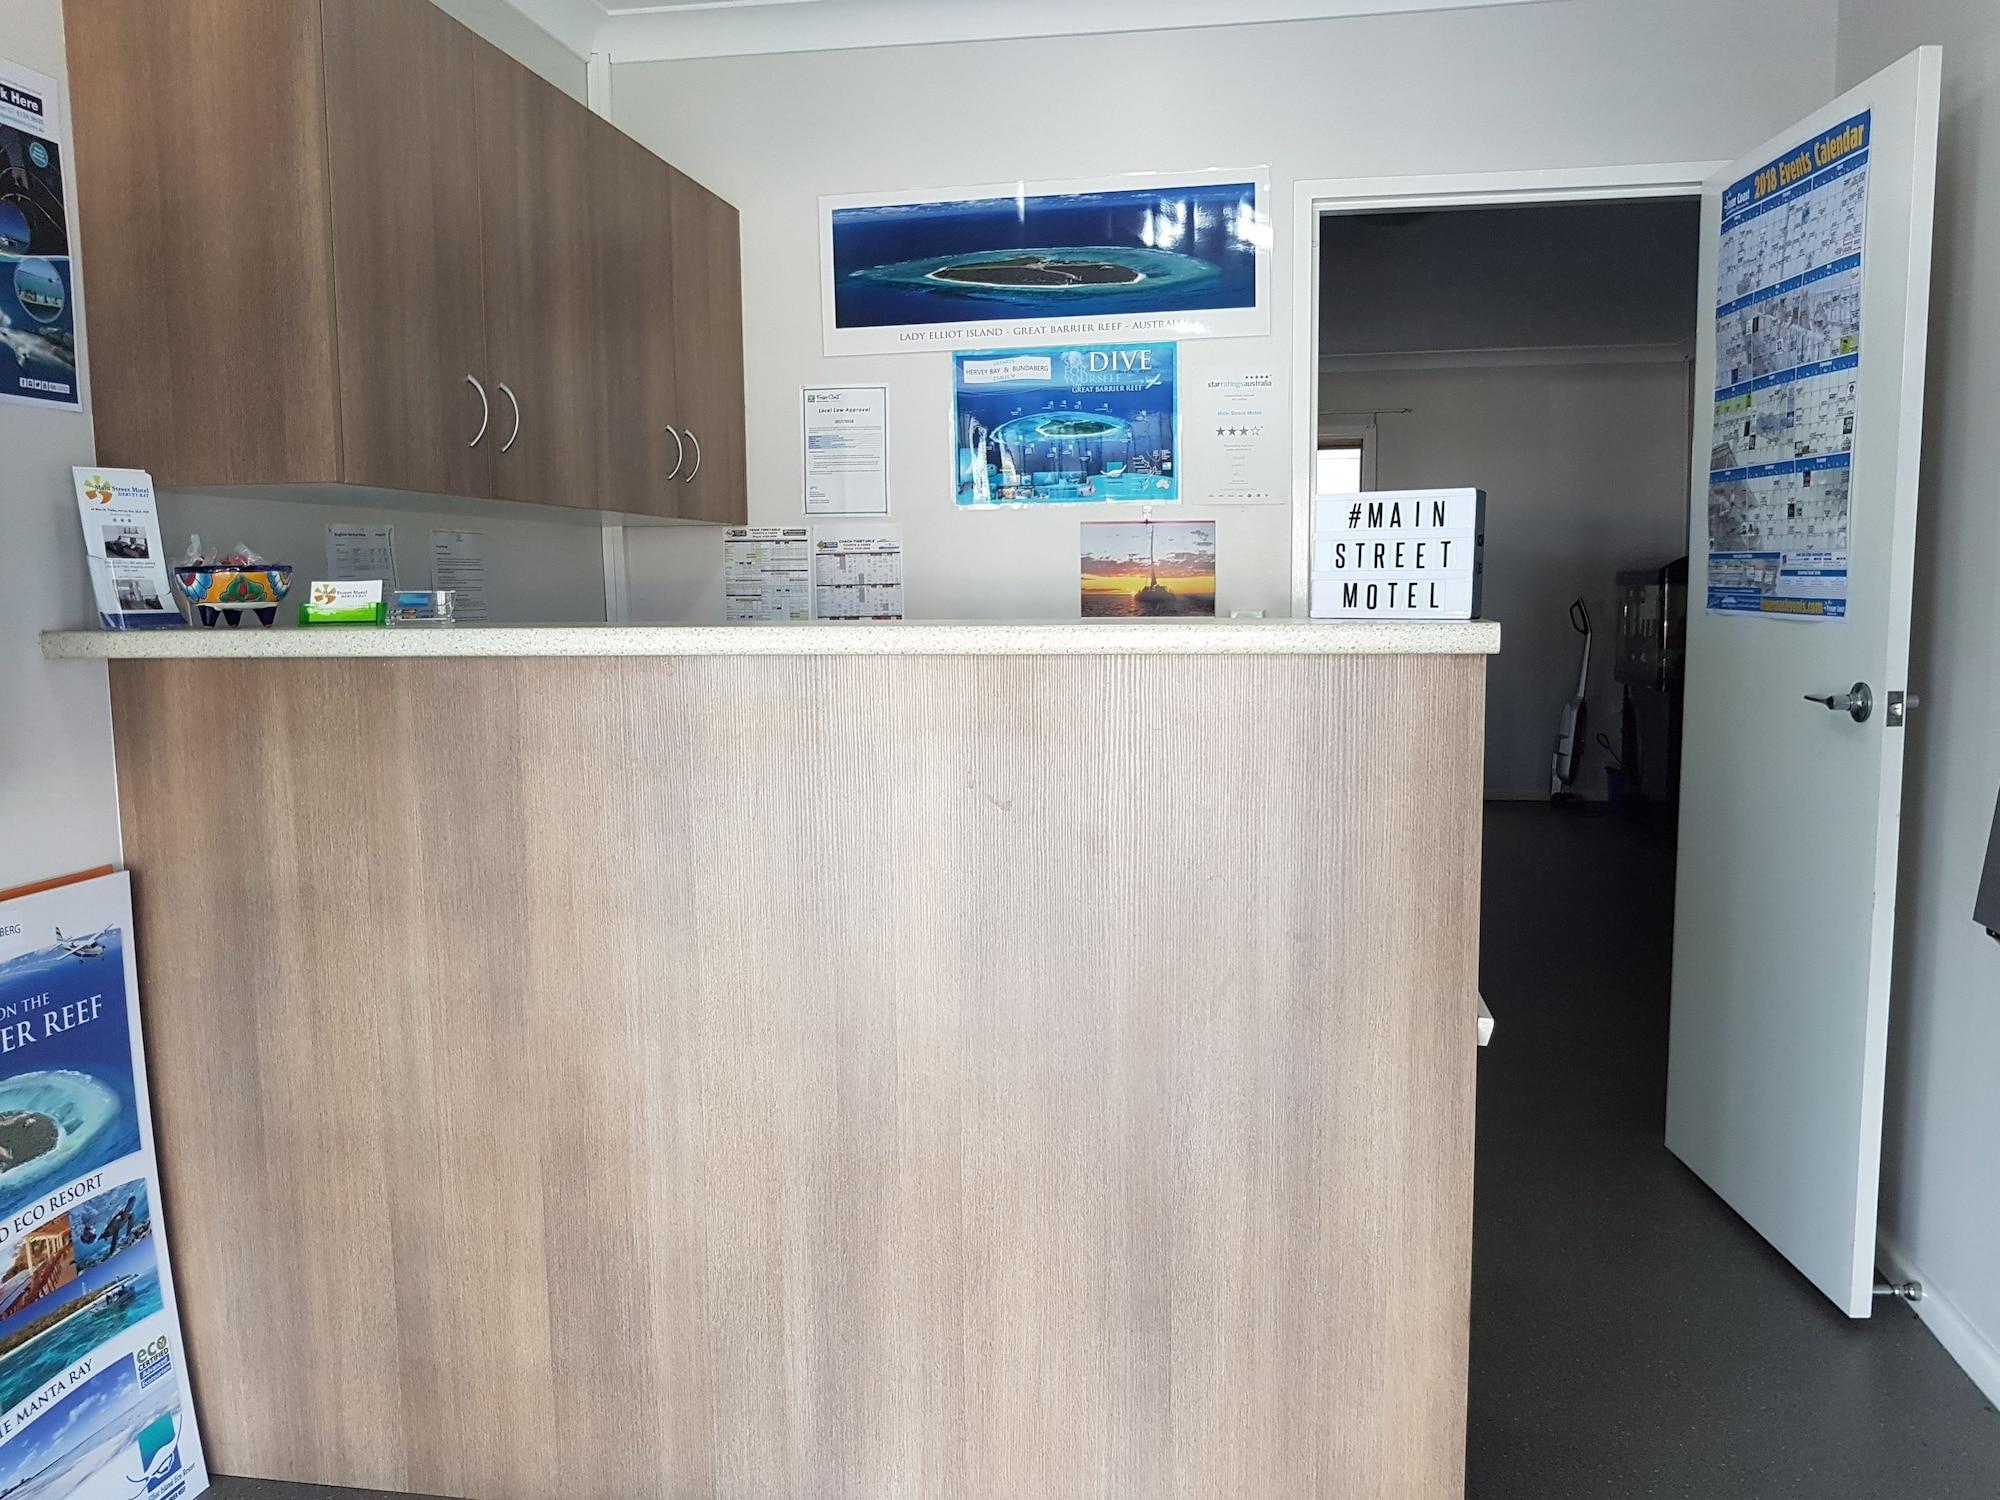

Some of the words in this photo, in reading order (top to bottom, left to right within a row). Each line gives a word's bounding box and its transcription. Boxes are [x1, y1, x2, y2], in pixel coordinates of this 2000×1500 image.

[11, 90, 39, 112] Here
[1754, 170, 1777, 198] 2018
[1779, 153, 1812, 185] Events
[1814, 122, 1865, 167] Calendar
[899, 332, 926, 341] LADY
[929, 331, 964, 340] ELLIOT
[966, 329, 1003, 338] ISLAND
[1013, 327, 1048, 335] GREAT
[1050, 325, 1095, 333] BARRIER
[1098, 323, 1123, 331] REEF
[1089, 349, 1152, 372] DIVE
[993, 373, 1016, 381] DAILY
[1095, 385, 1125, 393] BARRIER
[1126, 384, 1142, 392] REEF
[1348, 501, 1445, 529] #MAIN
[1335, 541, 1451, 569] STREET
[1343, 582, 1439, 610] MOTEL
[0, 923, 21, 938] BERG
[0, 1003, 17, 1022] ON
[21, 992, 51, 1014] THE
[44, 994, 104, 1038] REEF
[13, 1204, 46, 1235] ECO
[48, 1172, 104, 1212] RESORT
[136, 1335, 167, 1364] eco
[138, 1347, 169, 1371] CERTIFIED
[142, 1355, 169, 1378] Advanced
[16, 1379, 66, 1425] MANTA
[68, 1358, 94, 1385] RAY
[160, 1479, 174, 1494] Island
[174, 1473, 183, 1483] Eco
